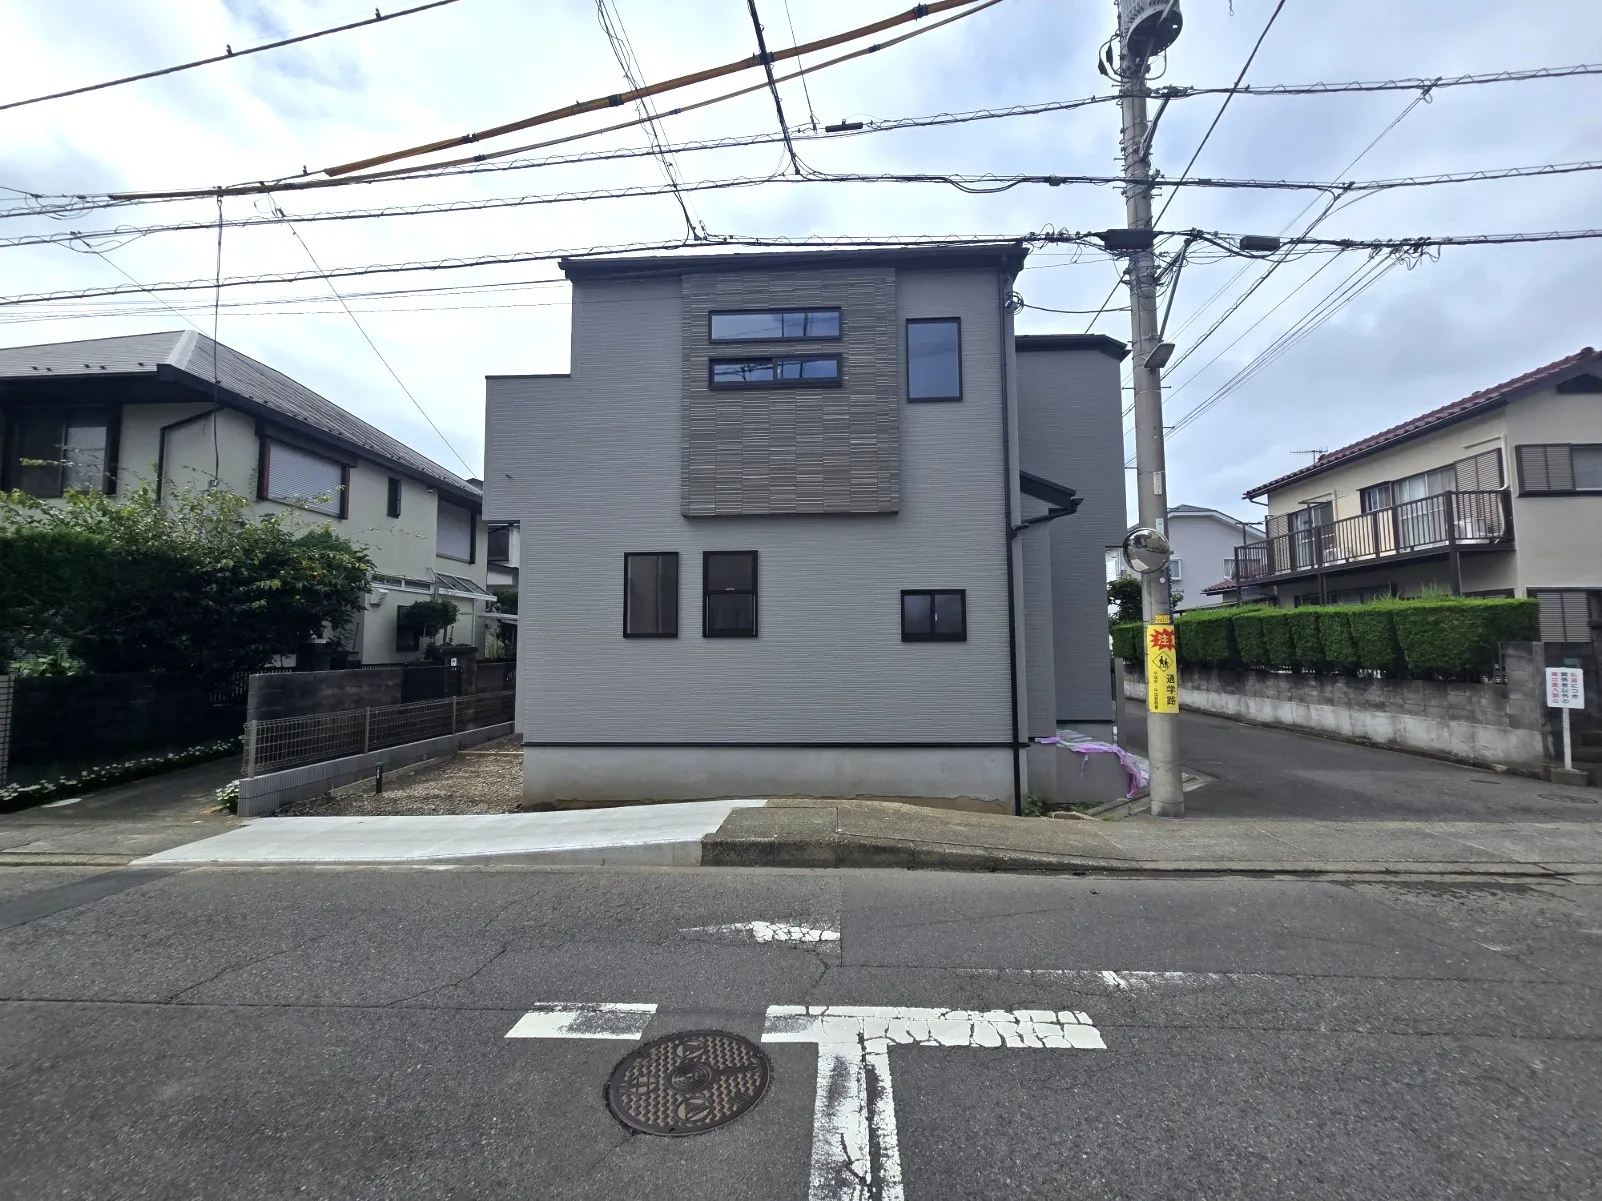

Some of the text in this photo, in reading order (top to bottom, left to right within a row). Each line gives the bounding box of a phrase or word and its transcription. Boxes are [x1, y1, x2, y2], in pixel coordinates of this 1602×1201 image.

[1166, 674, 1176, 705] 通学路
[1560, 672, 1569, 704] 関係者以外の
[1570, 672, 1579, 699] 私道につき
